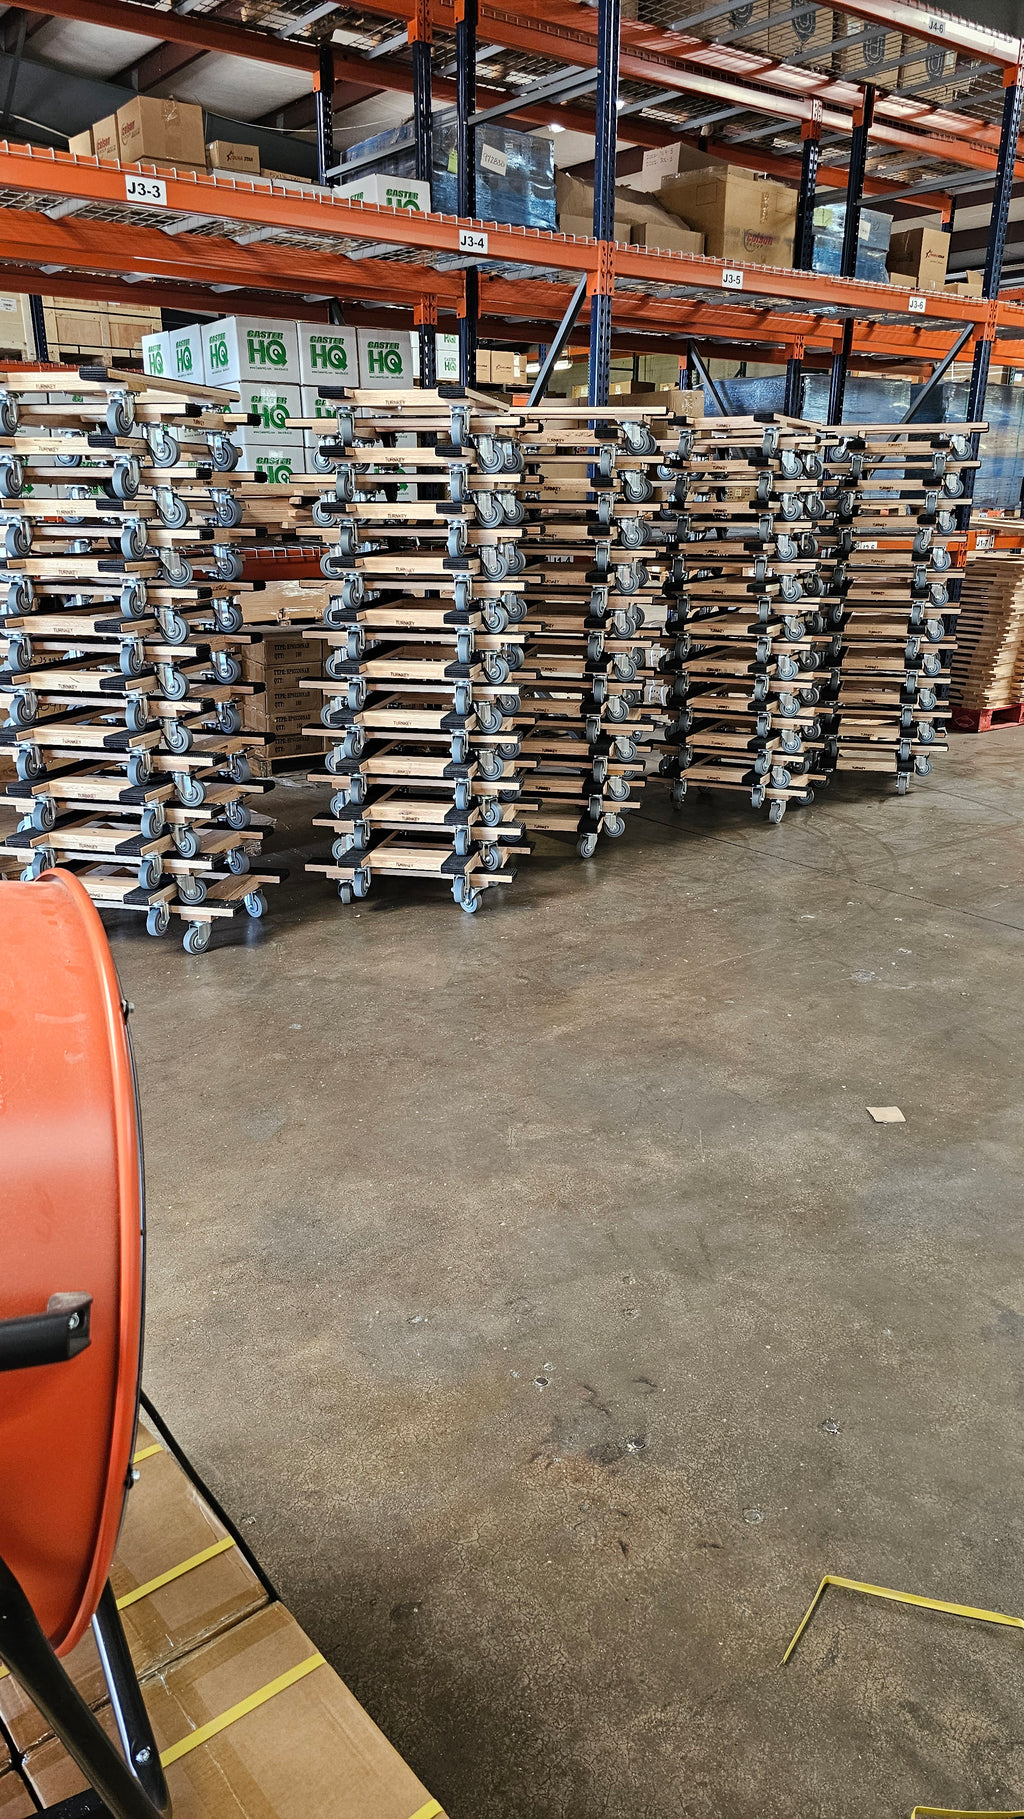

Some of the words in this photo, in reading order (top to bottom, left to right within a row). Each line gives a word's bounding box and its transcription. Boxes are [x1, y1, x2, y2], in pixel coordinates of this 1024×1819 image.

[928, 20, 944, 32] J4-6
[128, 182, 160, 198] J3-3
[386, 188, 418, 200] CASTER
[460, 236, 484, 248] J3-4
[722, 274, 741, 284] J3-5
[910, 298, 924, 310] J3-6
[208, 332, 226, 344] CASTER
[247, 330, 284, 340] CASTER
[310, 336, 344, 345] CASTER
[176, 338, 190, 350] CASTER
[368, 340, 400, 350] CASTER
[210, 340, 229, 369] HQ
[247, 338, 288, 366] HQ
[310, 344, 348, 371] HQ
[149, 352, 164, 374] HQ
[176, 346, 192, 373] HQ
[368, 349, 403, 374] HQ
[444, 362, 456, 372] HQ
[252, 403, 290, 429] HQ
